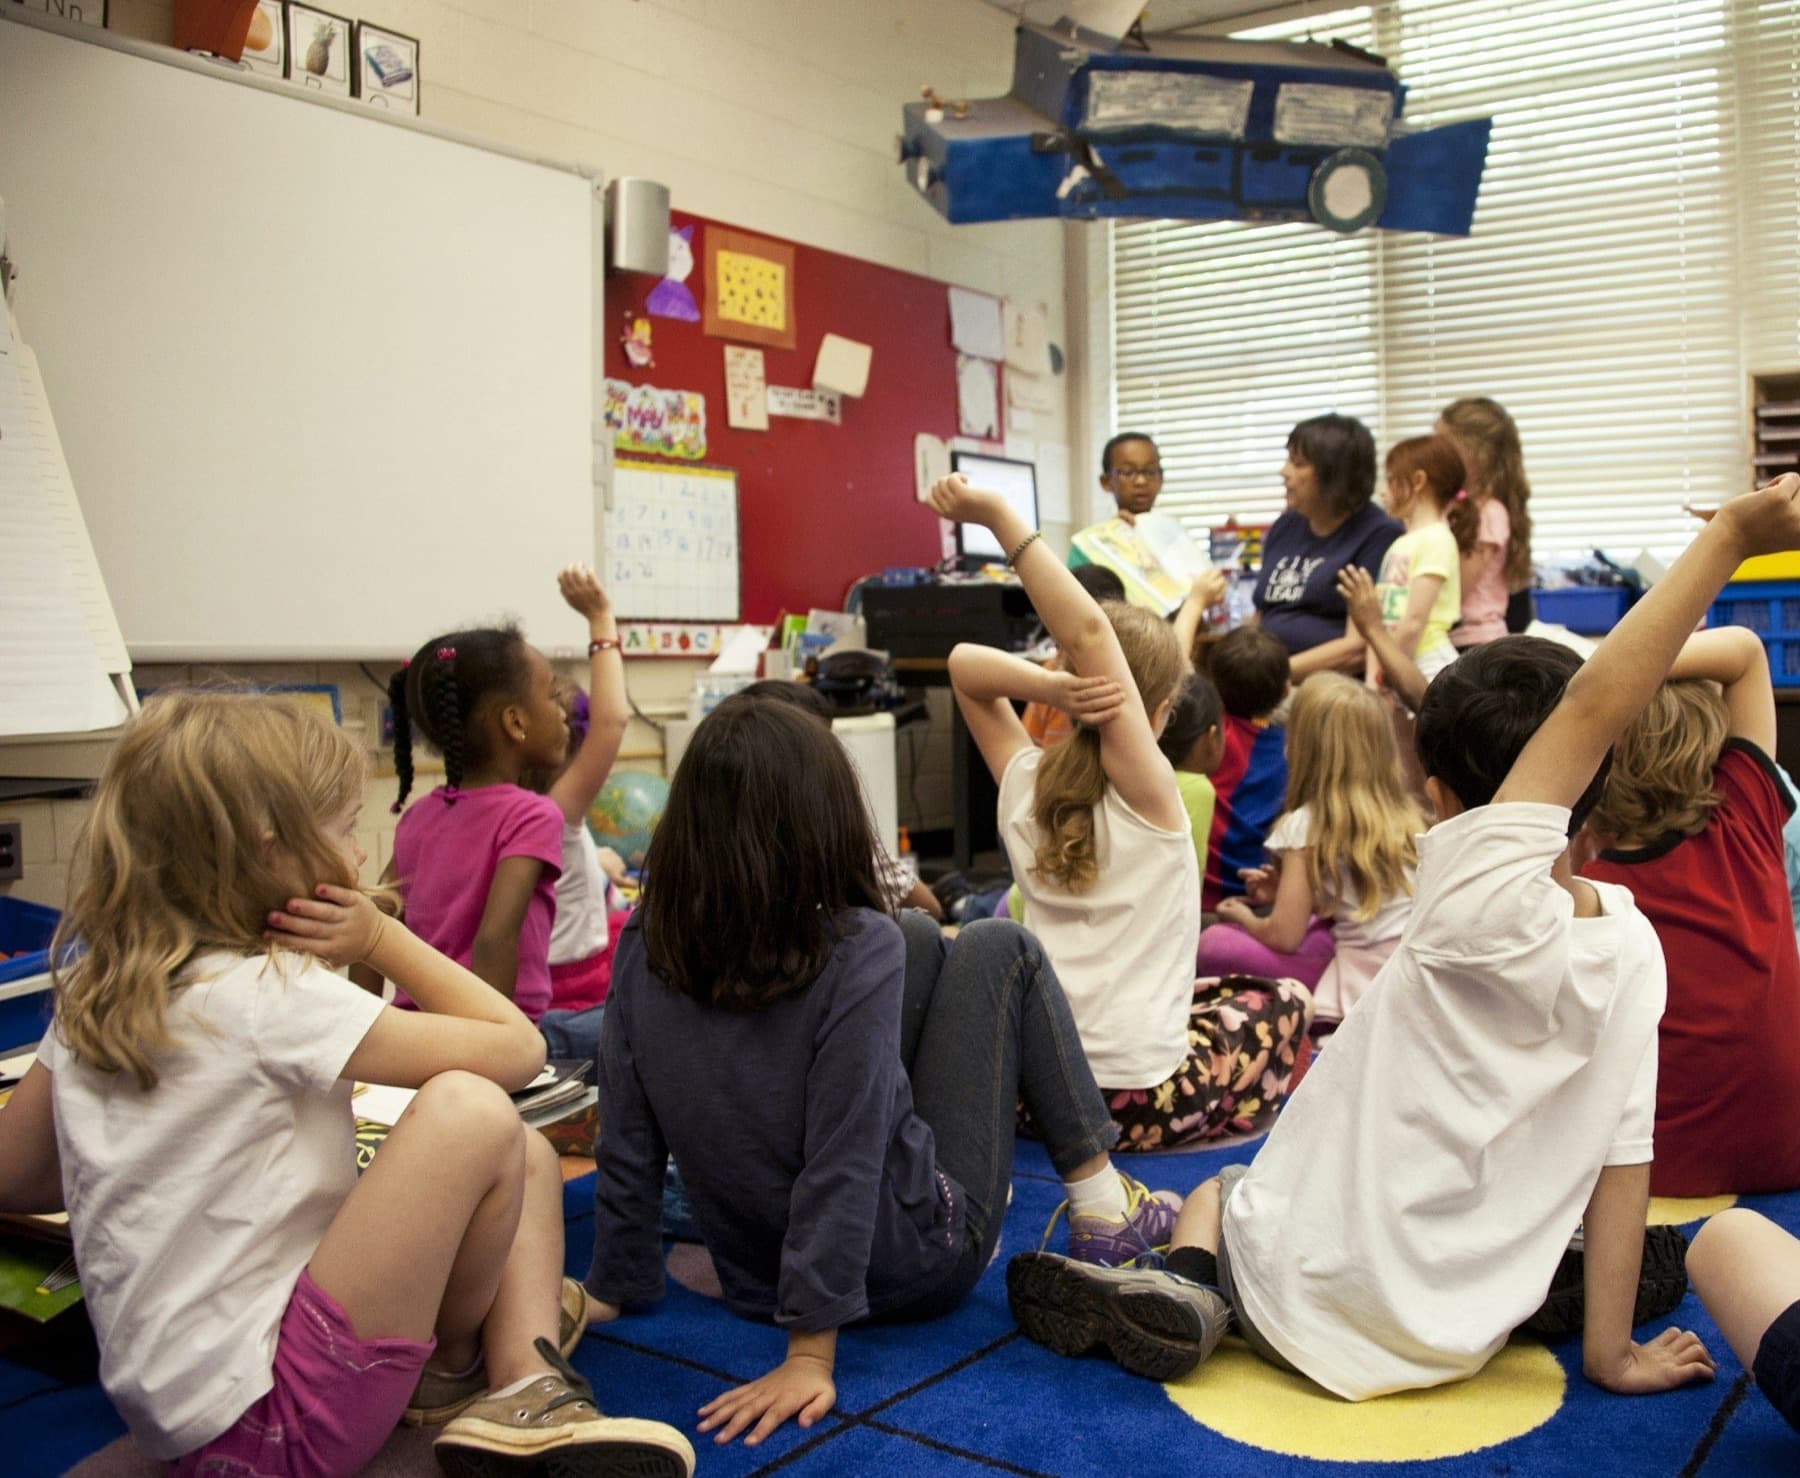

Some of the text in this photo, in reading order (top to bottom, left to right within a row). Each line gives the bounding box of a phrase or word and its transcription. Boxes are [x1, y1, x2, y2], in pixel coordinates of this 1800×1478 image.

[626, 629, 708, 649] A B C
